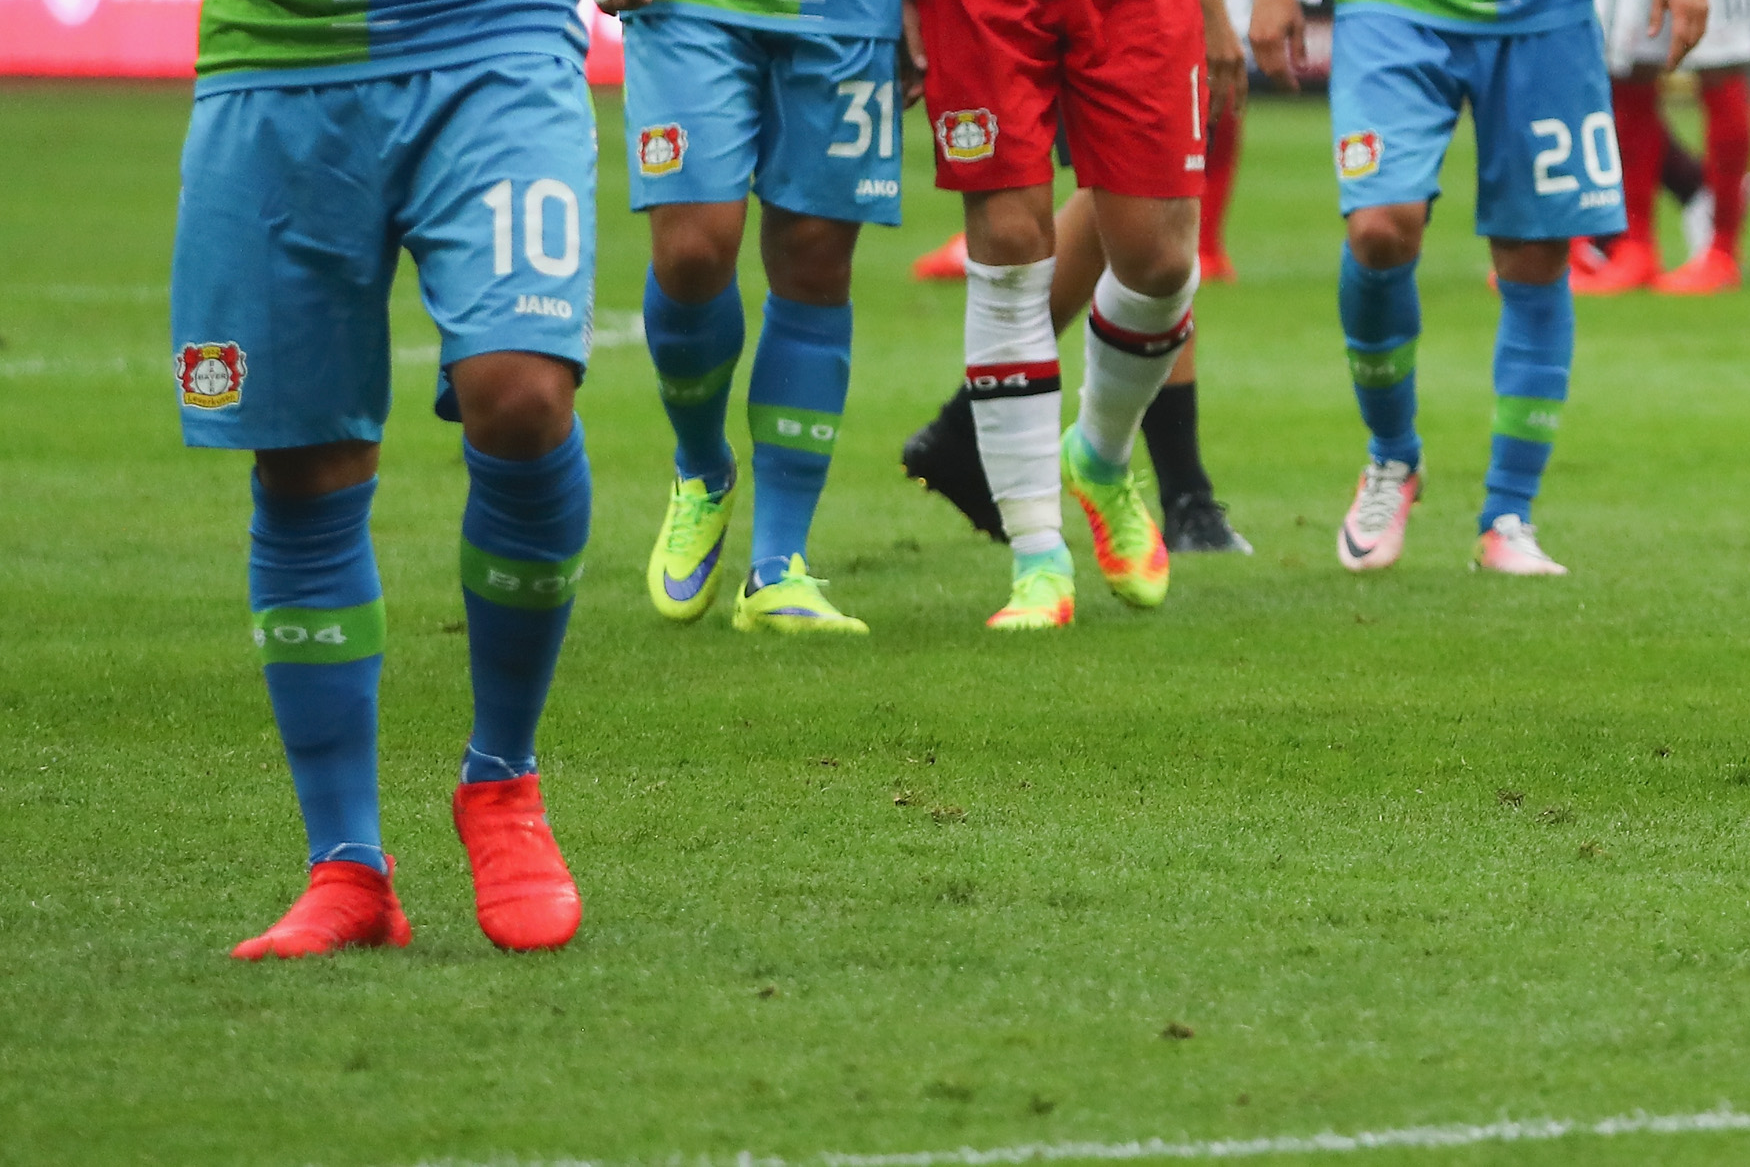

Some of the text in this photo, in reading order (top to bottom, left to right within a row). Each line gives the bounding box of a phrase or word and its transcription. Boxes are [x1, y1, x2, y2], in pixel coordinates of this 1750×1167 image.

[826, 80, 895, 159] 31
[1530, 110, 1623, 196] 20
[855, 178, 899, 198] JAKO
[1579, 188, 1621, 210] JAKO
[482, 177, 581, 278] 10
[514, 294, 573, 320] JAKO
